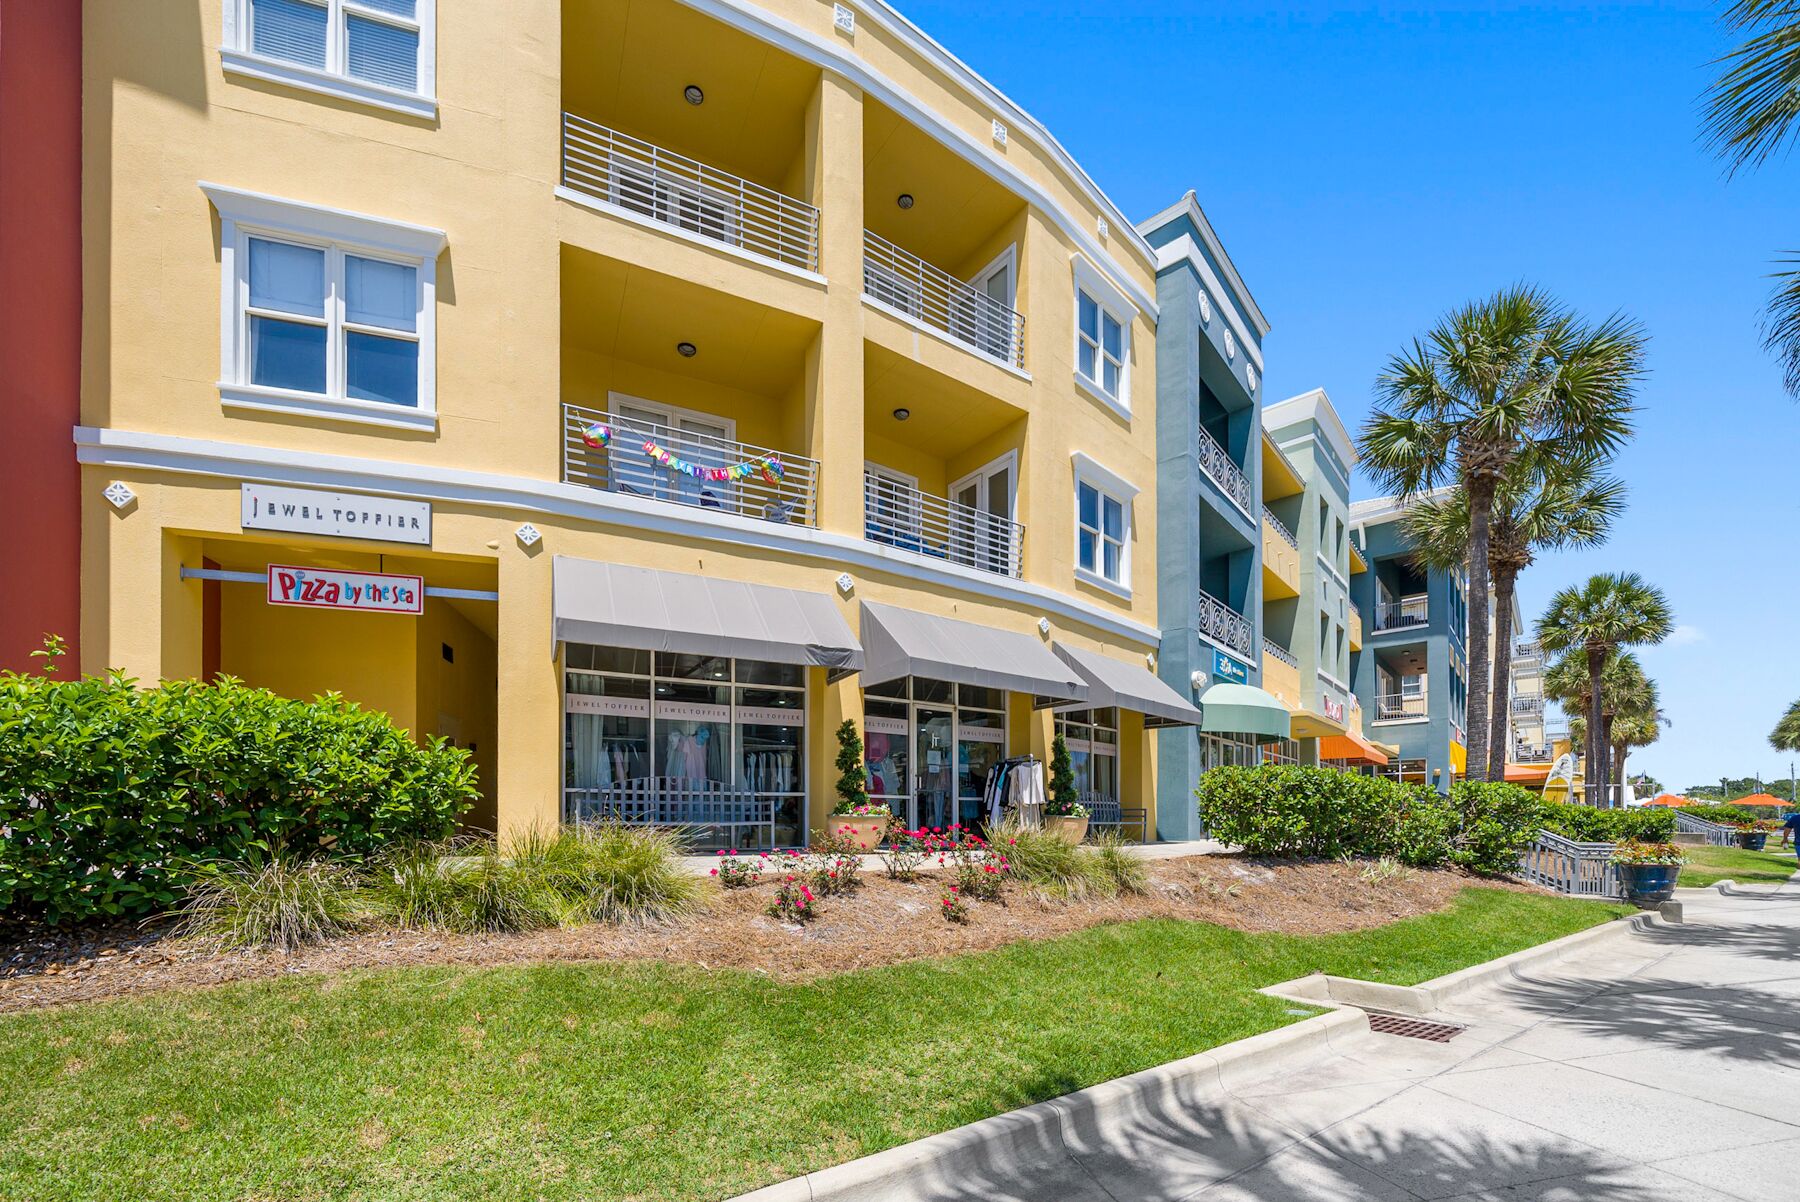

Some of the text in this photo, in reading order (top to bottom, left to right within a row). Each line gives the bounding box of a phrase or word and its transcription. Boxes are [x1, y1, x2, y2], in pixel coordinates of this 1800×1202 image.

[253, 496, 323, 520] JEWEL
[278, 571, 413, 604] Pizza by the Sea
[571, 697, 601, 709] JEWEL
[658, 705, 687, 714] JEWEL
